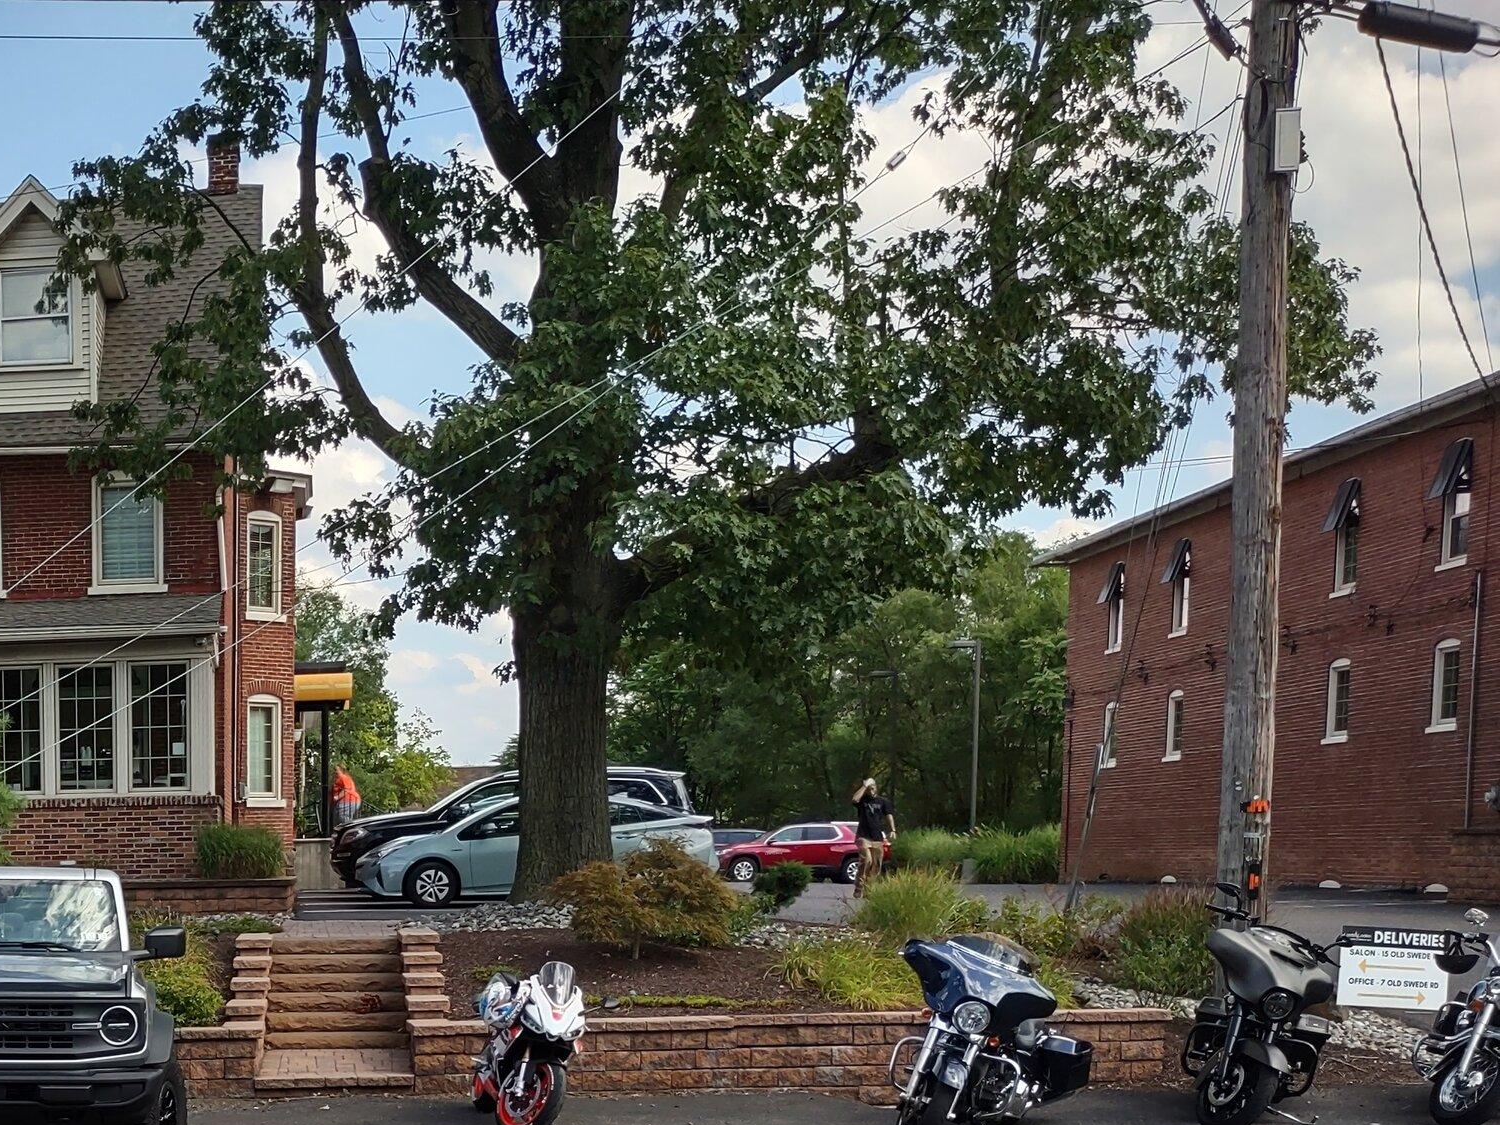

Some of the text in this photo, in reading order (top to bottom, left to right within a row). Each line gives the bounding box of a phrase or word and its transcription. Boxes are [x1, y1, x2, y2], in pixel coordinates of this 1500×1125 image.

[1349, 949, 1376, 957] SALON
[1406, 952, 1431, 960] SWEDE
[1348, 977, 1375, 986] OFFICE
[1387, 979, 1402, 987] OLD
[1403, 980, 1428, 988] SWEDE
